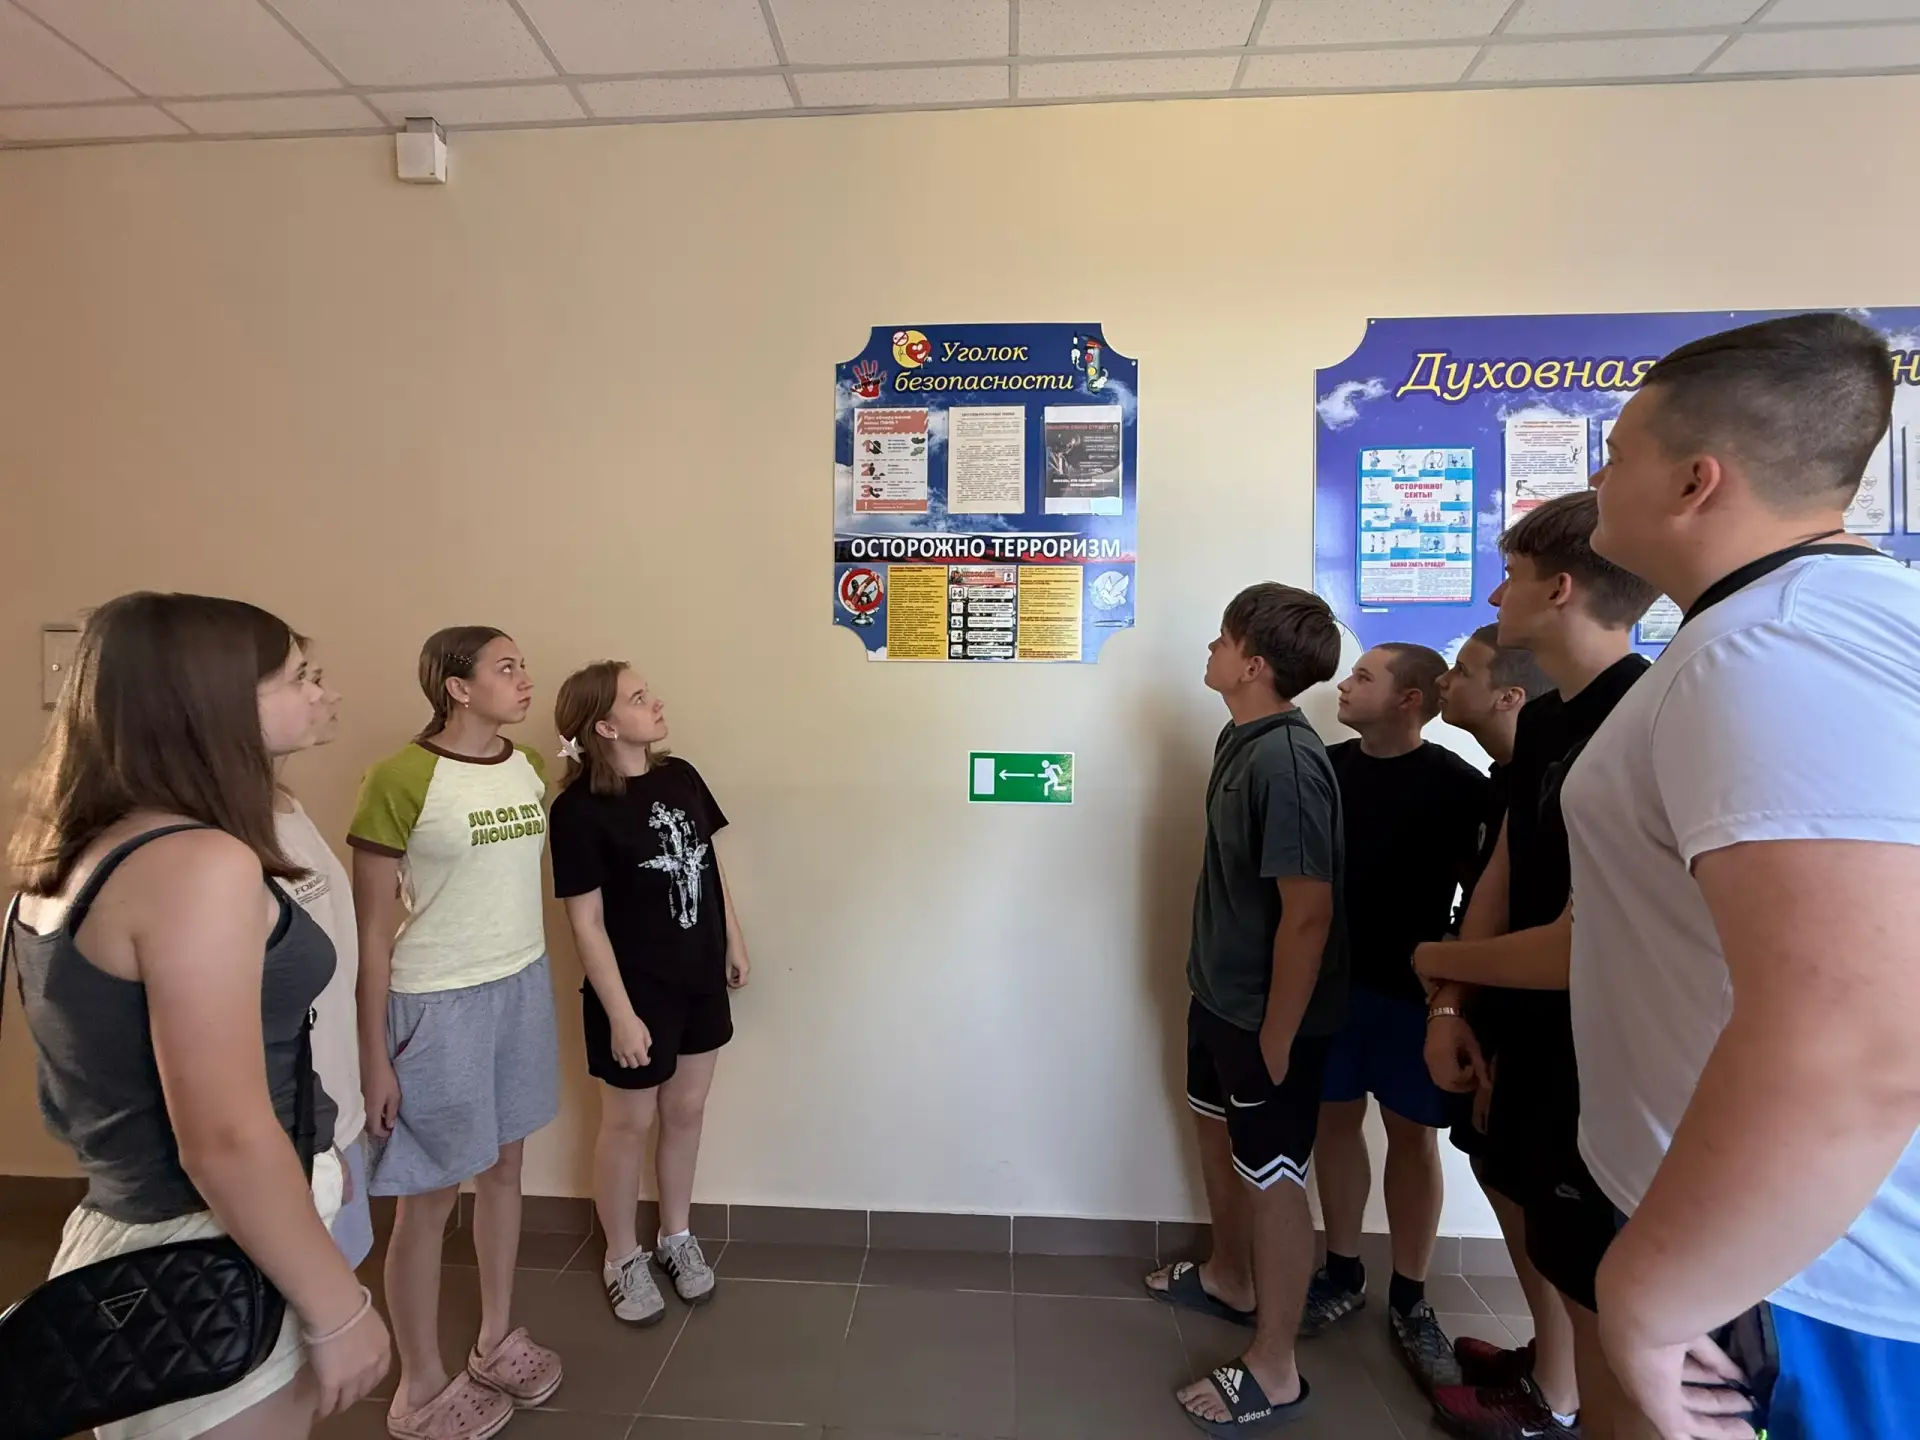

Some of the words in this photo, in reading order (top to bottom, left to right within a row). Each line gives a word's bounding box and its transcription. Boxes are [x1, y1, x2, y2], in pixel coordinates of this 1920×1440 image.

[940, 341, 1029, 364] Уголок
[894, 371, 1075, 393] безопасности
[1395, 351, 1656, 402] Духовная
[851, 537, 985, 559] ОСТОРОЖНО
[991, 537, 1121, 559] ТЕРРОРИЗМ
[468, 809, 495, 828] SUN
[495, 806, 519, 823] ON
[518, 803, 541, 819] MY
[1213, 1368, 1240, 1404] adidas
